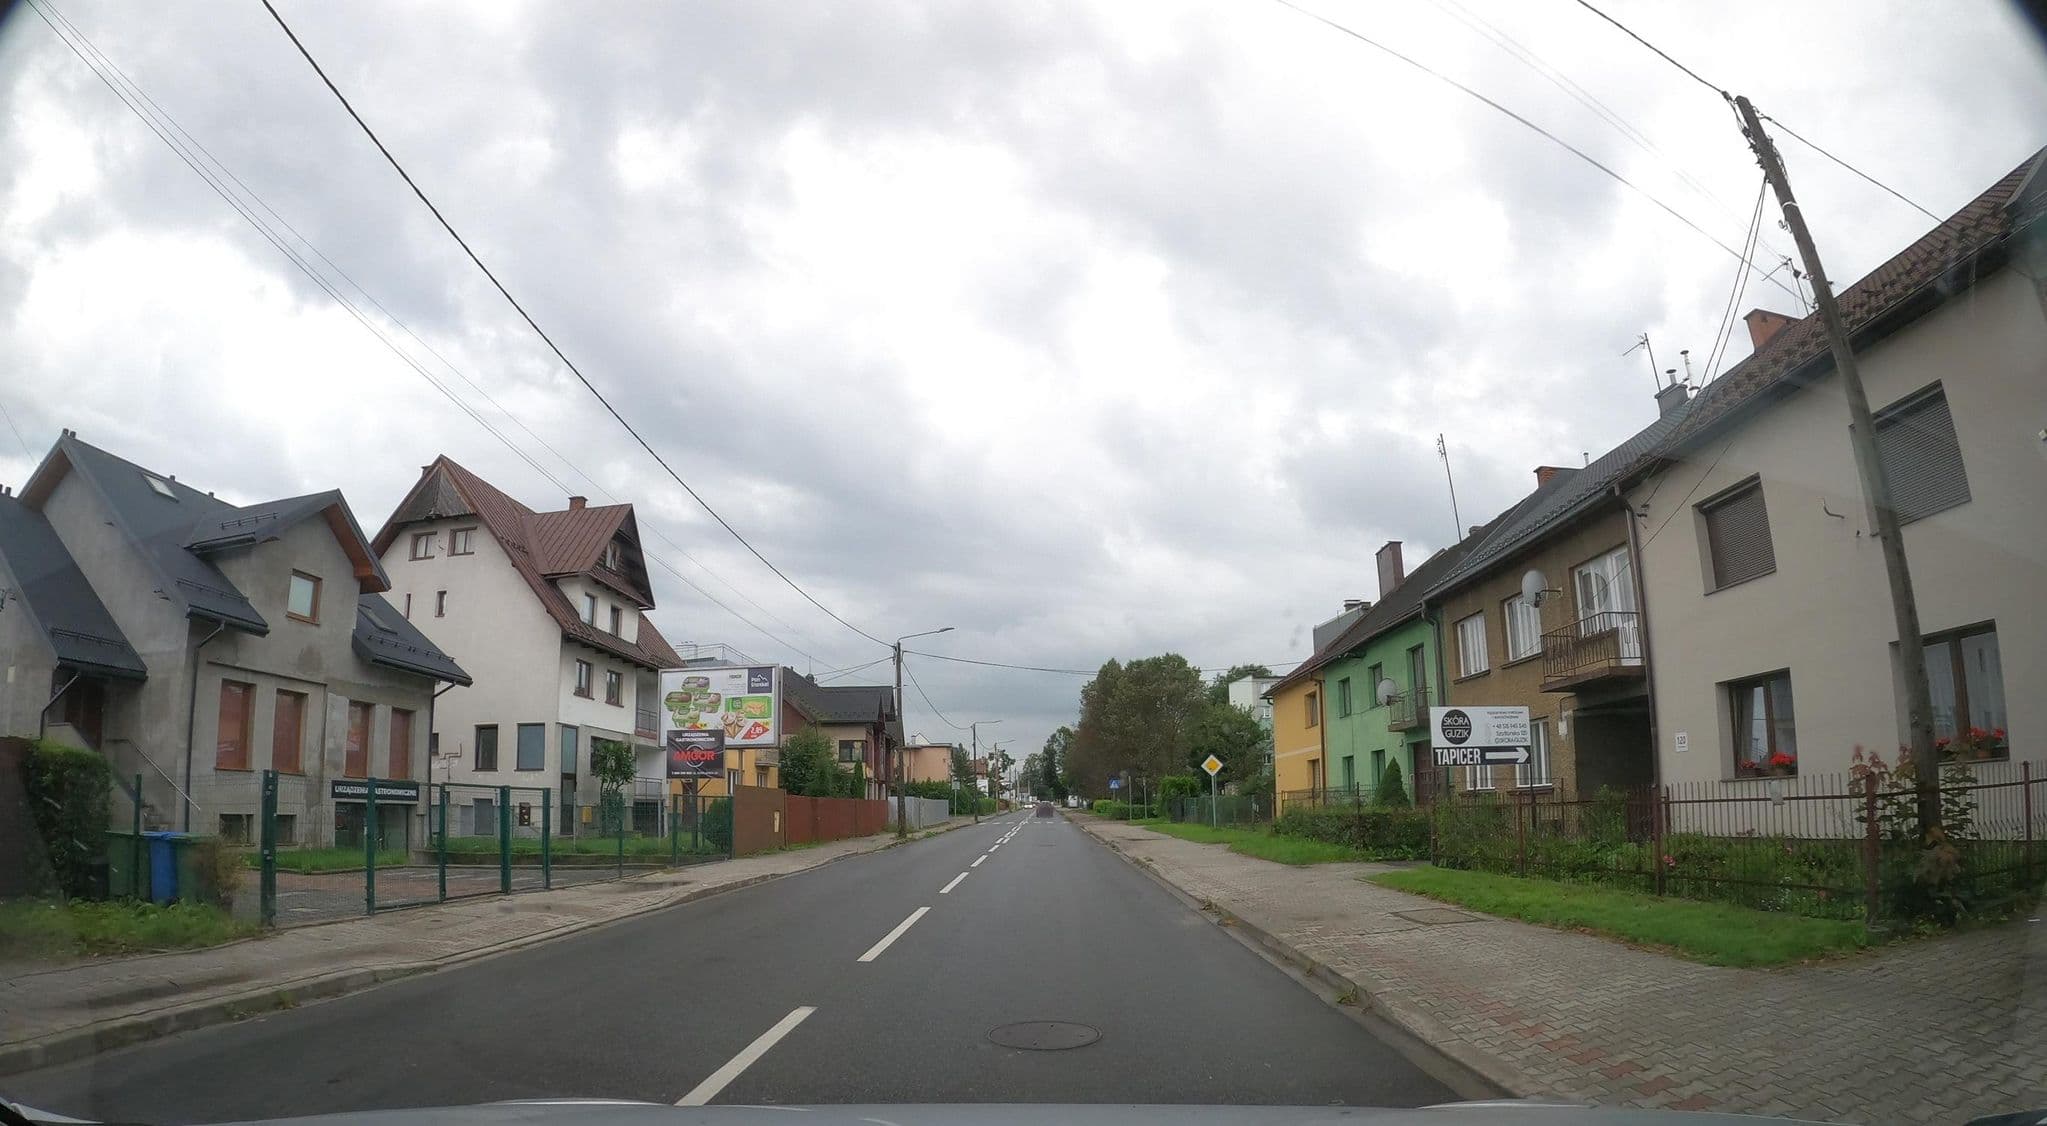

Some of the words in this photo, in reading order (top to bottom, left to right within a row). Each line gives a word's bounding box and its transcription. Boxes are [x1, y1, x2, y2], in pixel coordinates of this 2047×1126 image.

[1443, 715, 1470, 726] SKÓRA
[1444, 729, 1469, 738] GUZIK
[673, 751, 715, 760] AMGOR
[1435, 748, 1481, 765] TAPICER
